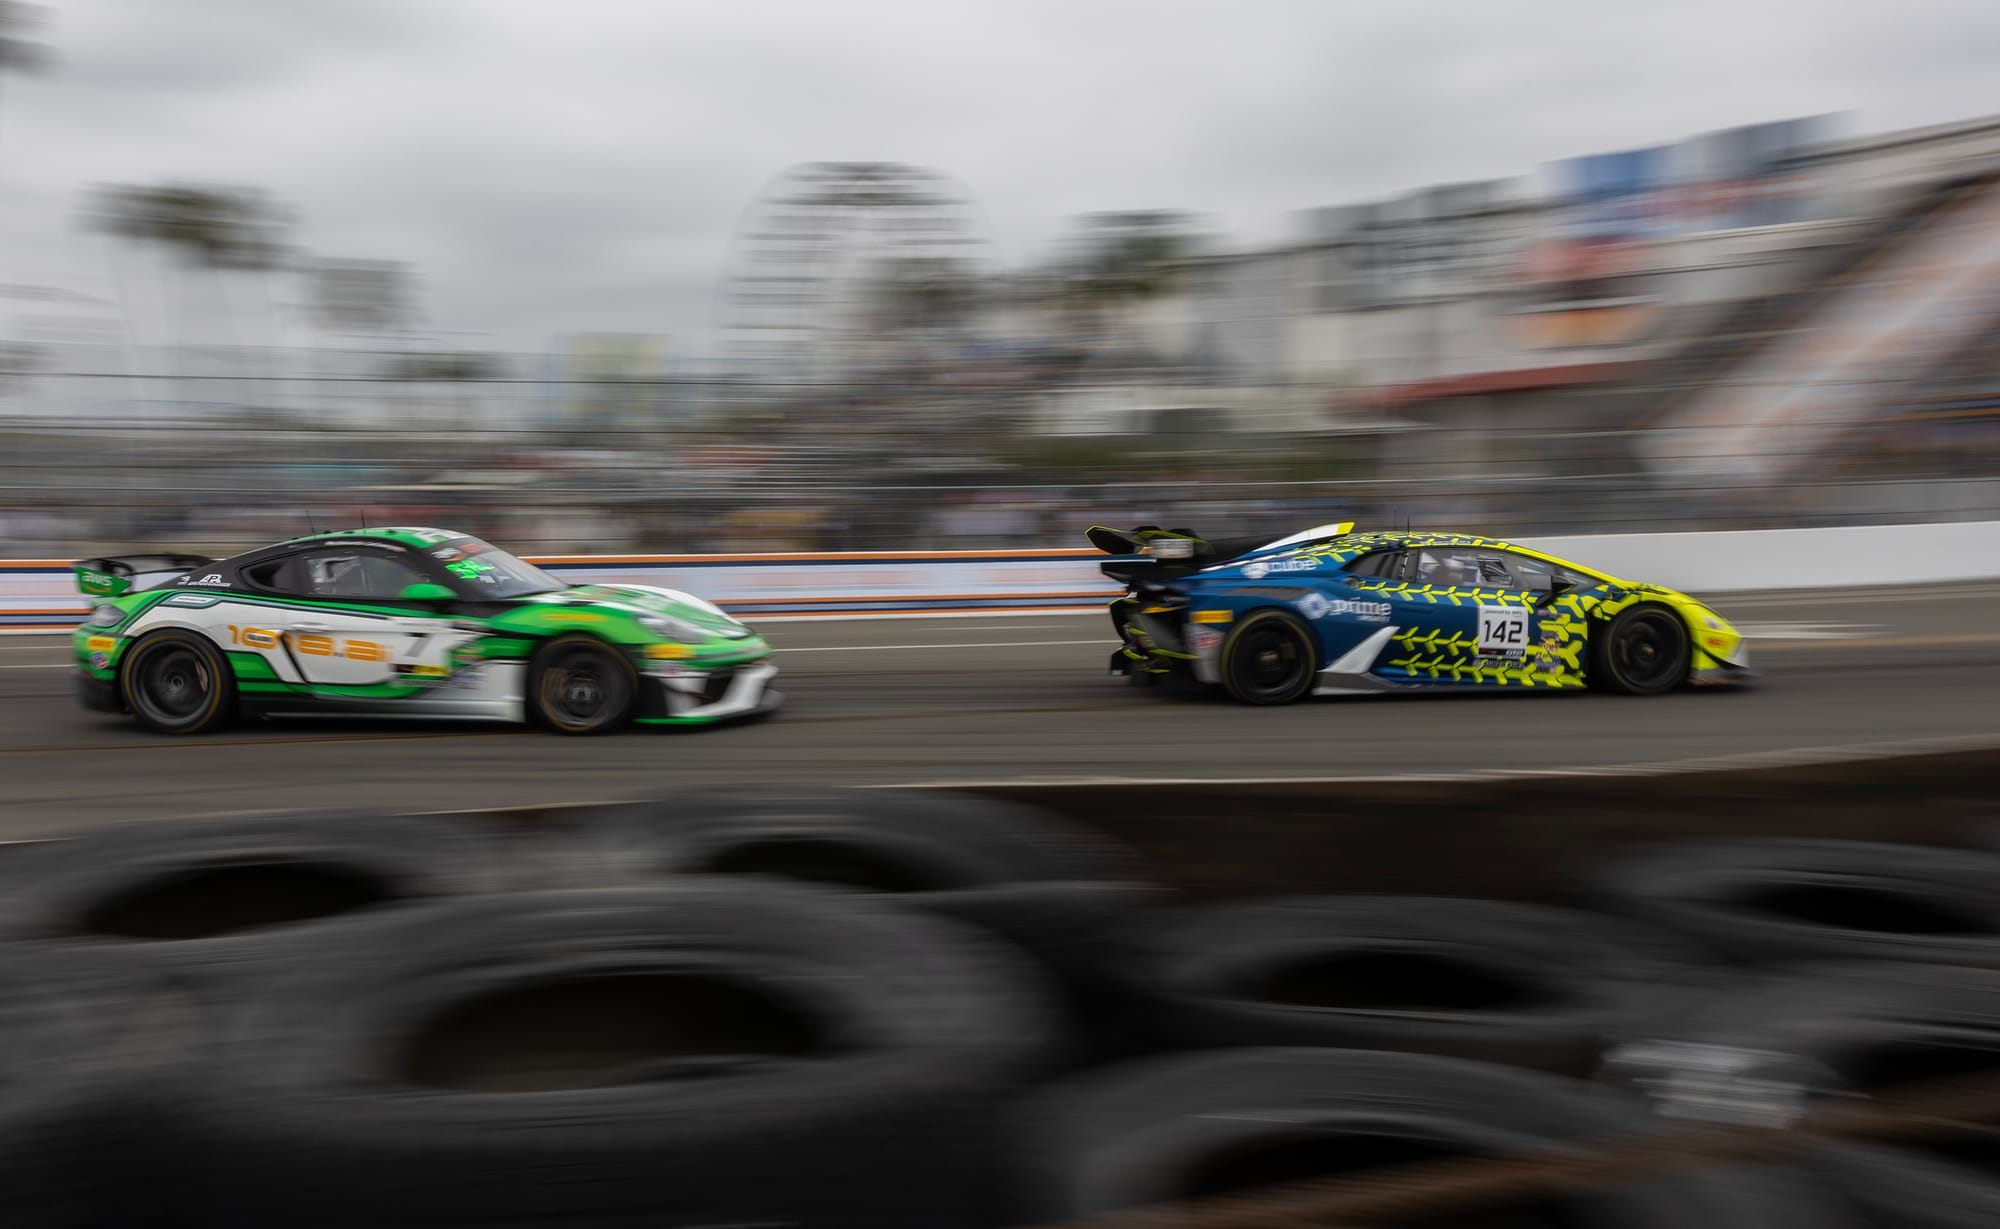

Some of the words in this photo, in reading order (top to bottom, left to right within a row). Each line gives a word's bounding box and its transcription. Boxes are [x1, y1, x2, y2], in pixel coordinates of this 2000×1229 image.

[81, 571, 113, 587] aws
[1328, 597, 1392, 616] prime
[1485, 620, 1523, 643] 142
